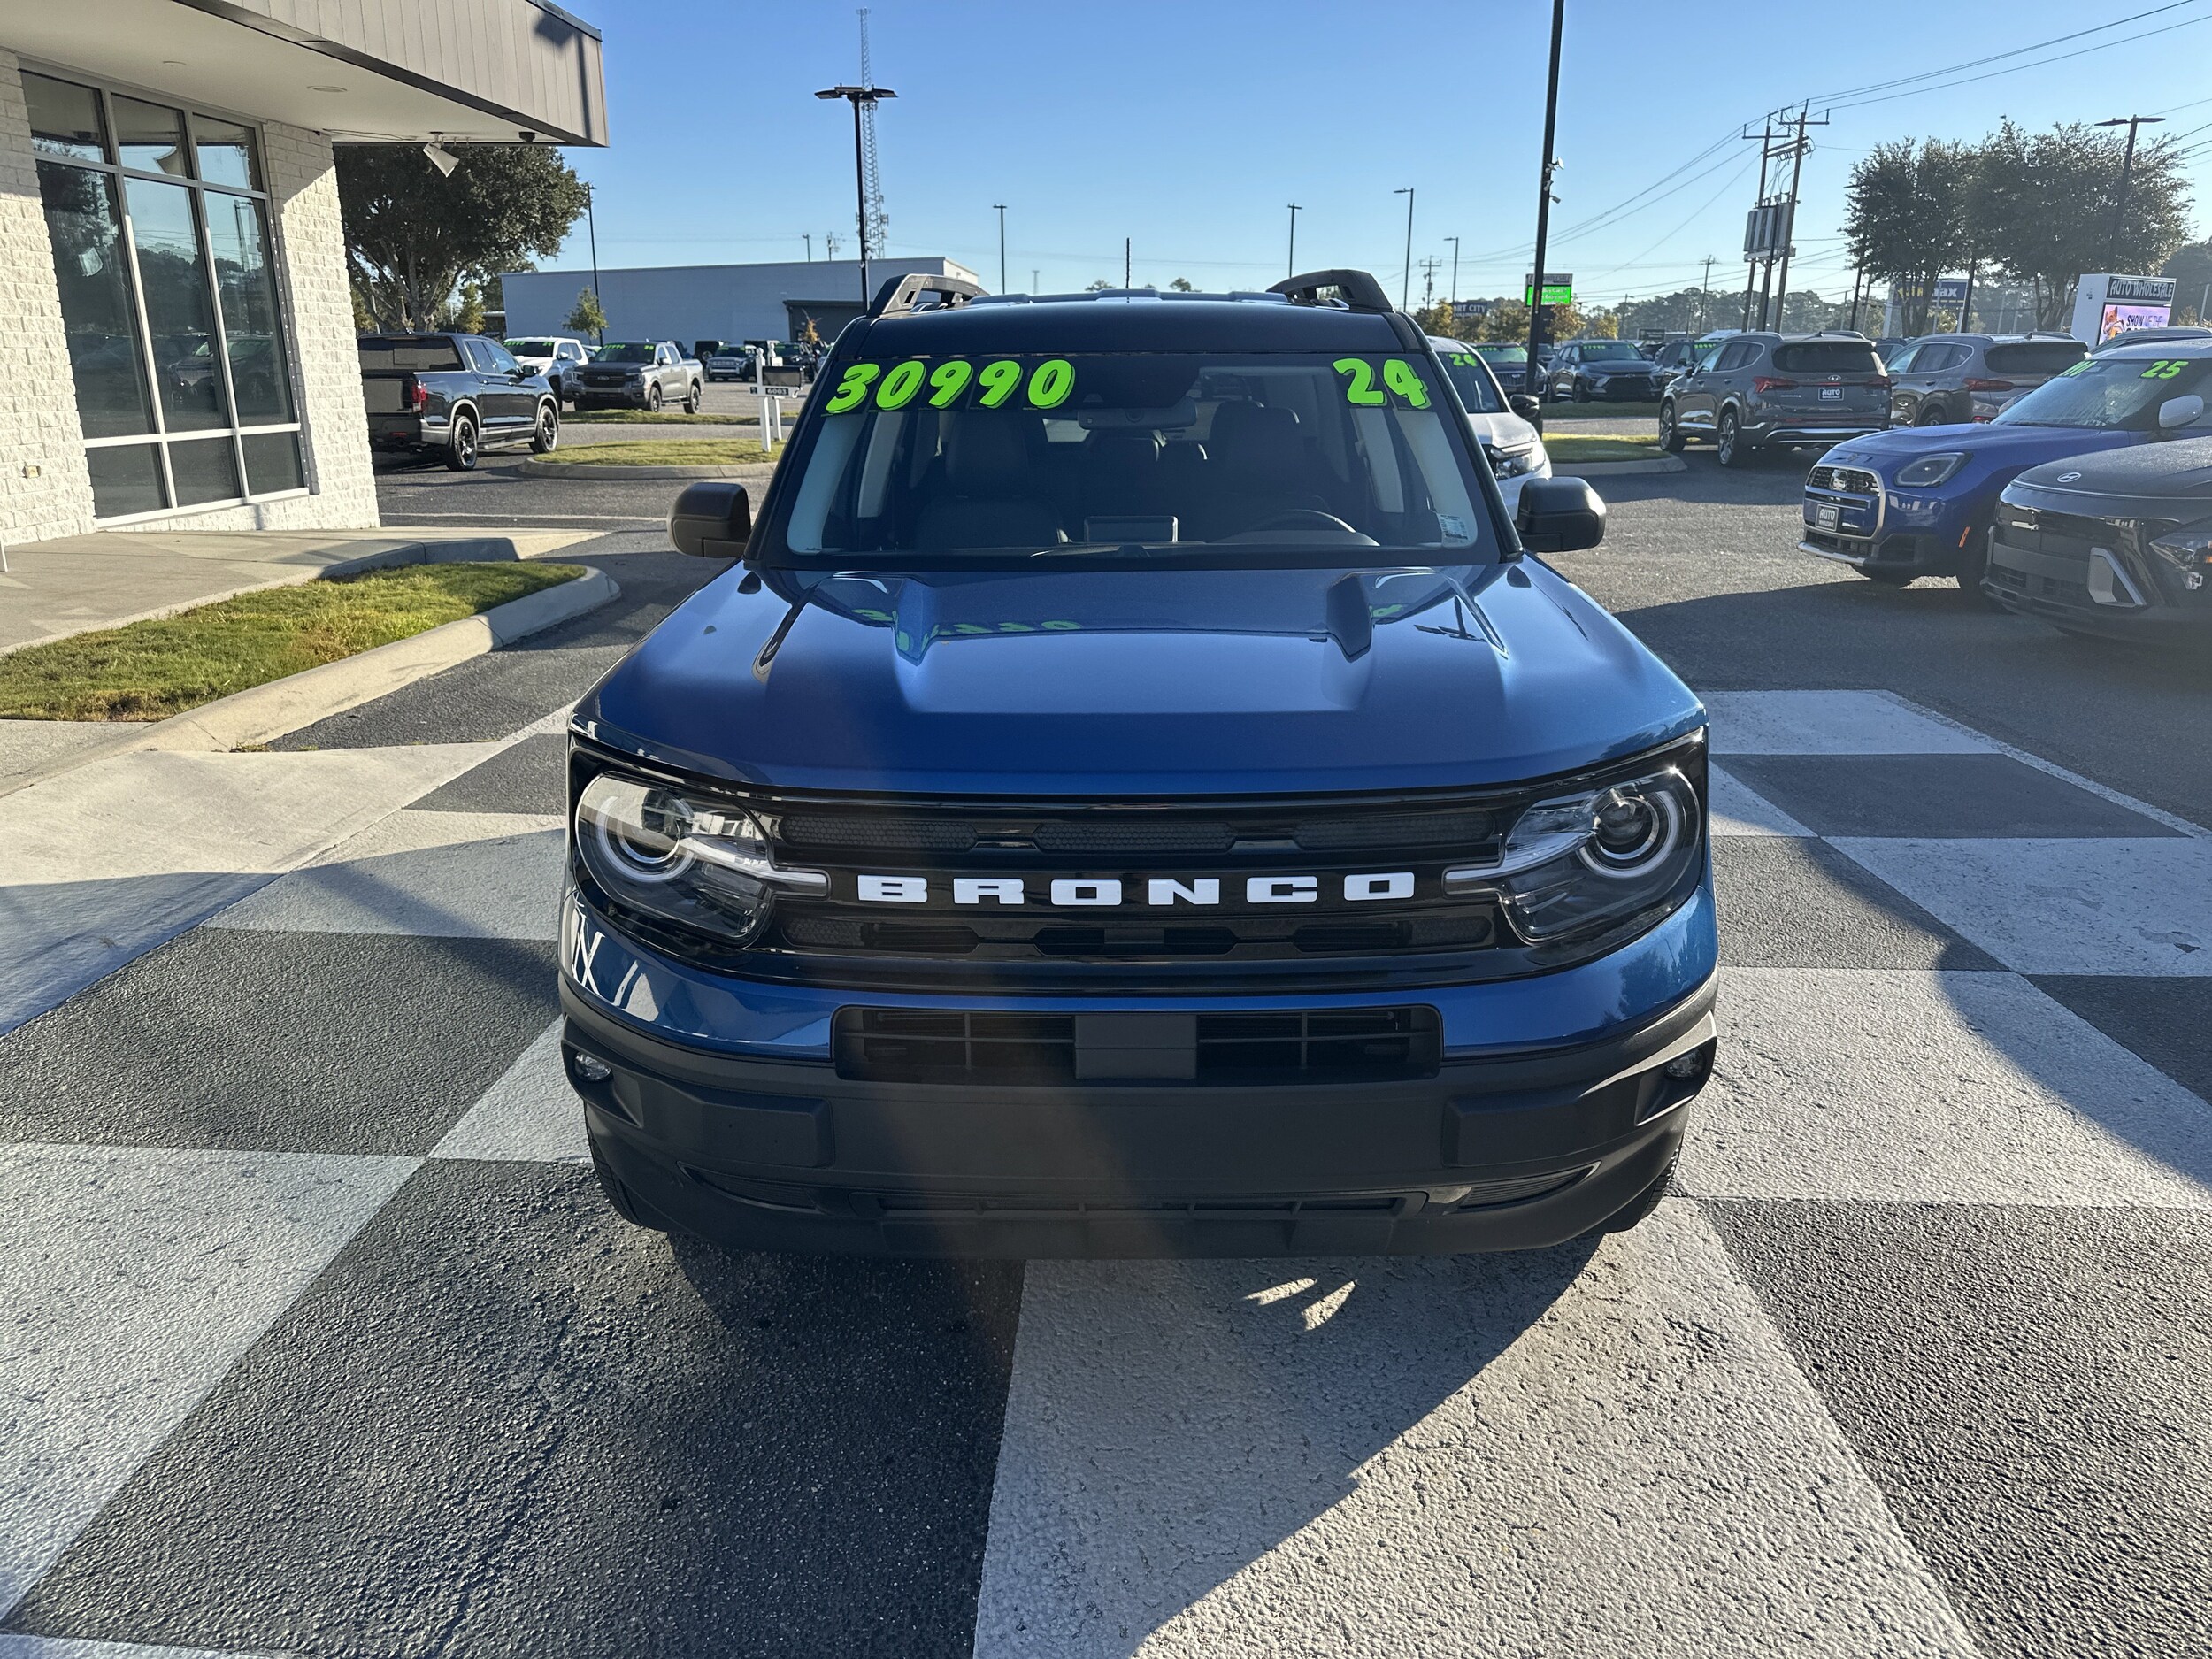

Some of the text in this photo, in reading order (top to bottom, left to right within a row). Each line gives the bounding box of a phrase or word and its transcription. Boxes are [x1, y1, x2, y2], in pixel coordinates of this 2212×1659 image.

[2110, 280, 2174, 298] AUTO WHOLESALE
[2126, 314, 2145, 327] SHOW
[2139, 360, 2189, 380] 25
[826, 359, 1075, 414] 30990
[1333, 357, 1432, 409] 24
[1819, 508, 1836, 521] AUTO
[857, 872, 1415, 905] BRONCO
